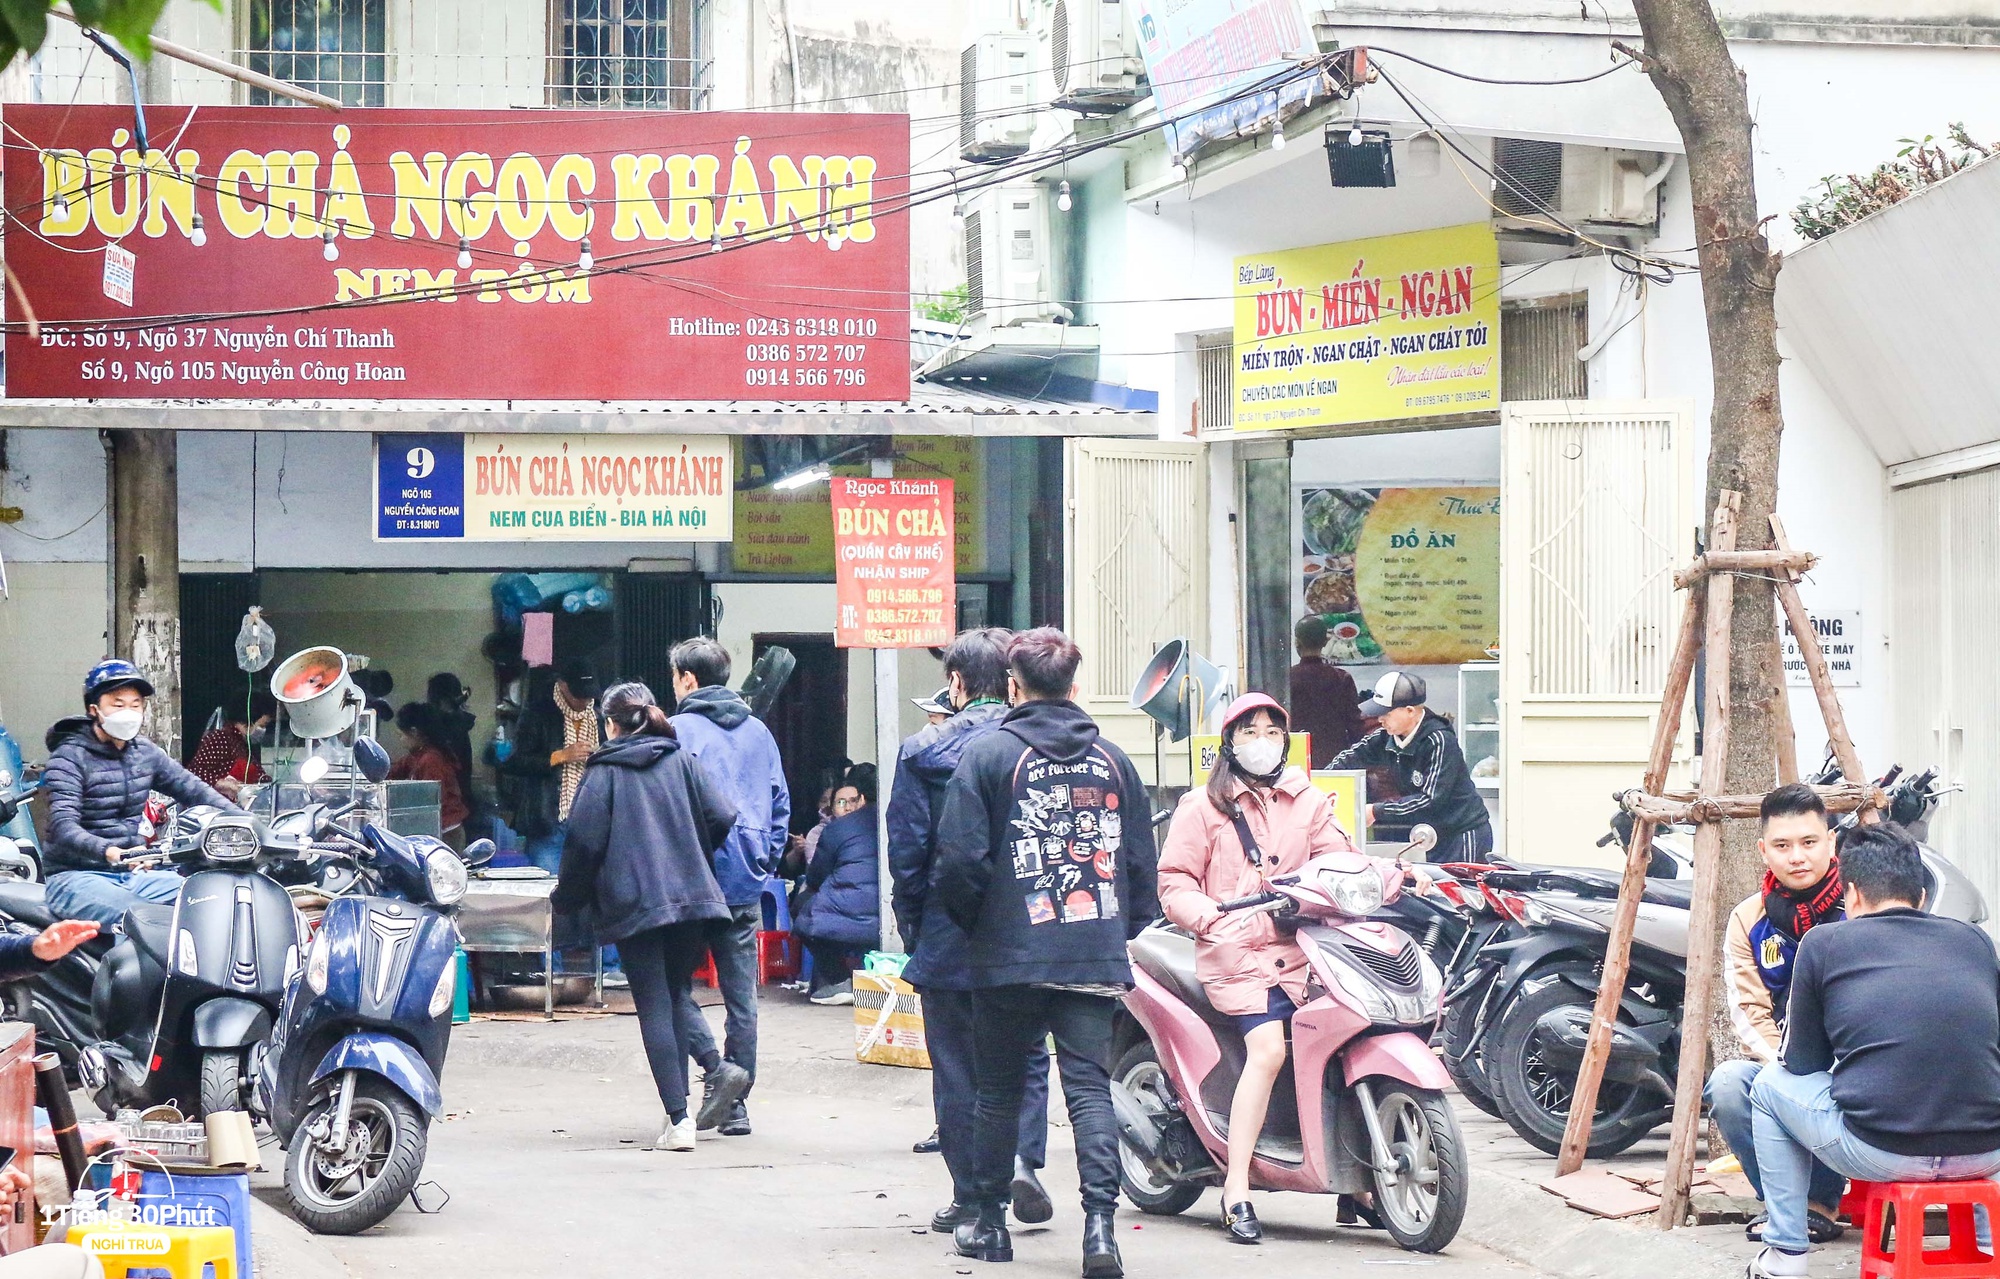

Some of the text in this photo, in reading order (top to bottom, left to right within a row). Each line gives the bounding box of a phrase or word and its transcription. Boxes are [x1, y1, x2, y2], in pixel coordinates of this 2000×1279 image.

[38, 124, 878, 257] BÚN CHẢ NGỌC KHÁNH
[1239, 263, 1275, 284] Bếp Làng
[333, 268, 458, 303] NEM
[1257, 278, 1303, 337] BÚN
[1400, 266, 1473, 320] NGAN
[668, 317, 878, 337] Hotline: 0243 8318 010
[40, 324, 395, 352] ĐC: Số 9, Ngõ 37 Nguyễn Chí Thanh
[1273, 346, 1304, 374] TRỘN
[1313, 344, 1345, 364] NGAN
[1349, 336, 1381, 367] CHẶT
[1390, 335, 1425, 355] NGAN
[1428, 328, 1462, 350] CHÁY
[1465, 321, 1488, 345] TỎI
[746, 344, 866, 362] 0386 572 707
[81, 358, 106, 380] Số
[111, 361, 128, 383] 9,
[135, 360, 174, 384] Ngõ
[180, 361, 215, 380] 105
[221, 358, 294, 384] Nguyễn
[299, 360, 349, 384] Công
[745, 368, 866, 386] 0914 566 796
[1387, 365, 1417, 386] Nhận
[1450, 364, 1464, 378] các
[1242, 383, 1270, 402] CHUYÊN
[1317, 380, 1338, 396] NGAN
[406, 447, 435, 479] 9
[475, 443, 723, 506] BÚN CHẢ NGỌC KHÁNH
[402, 486, 432, 499] NGÕ 105
[845, 480, 885, 498] Ngọc
[889, 480, 939, 495] Khánh
[415, 503, 437, 516] CÔNG
[438, 506, 460, 516] HOAN
[489, 502, 707, 530] NEM CUA BIỂN BIA HÀ NỘI
[837, 498, 947, 537] BÚN CHẢ
[1391, 527, 1456, 548] ĐỒ ĂN
[841, 541, 944, 563] (QUÁN CÂY KHẾ)
[854, 566, 930, 582] NHẬN SHIP
[867, 589, 943, 603] 0914.566.796
[866, 609, 943, 624] 0386.572.707
[1833, 643, 1854, 655] MÁY
[1831, 659, 1851, 671] NHÀ
[1028, 769, 1045, 782] are
[1295, 1021, 1316, 1031] HONDA
